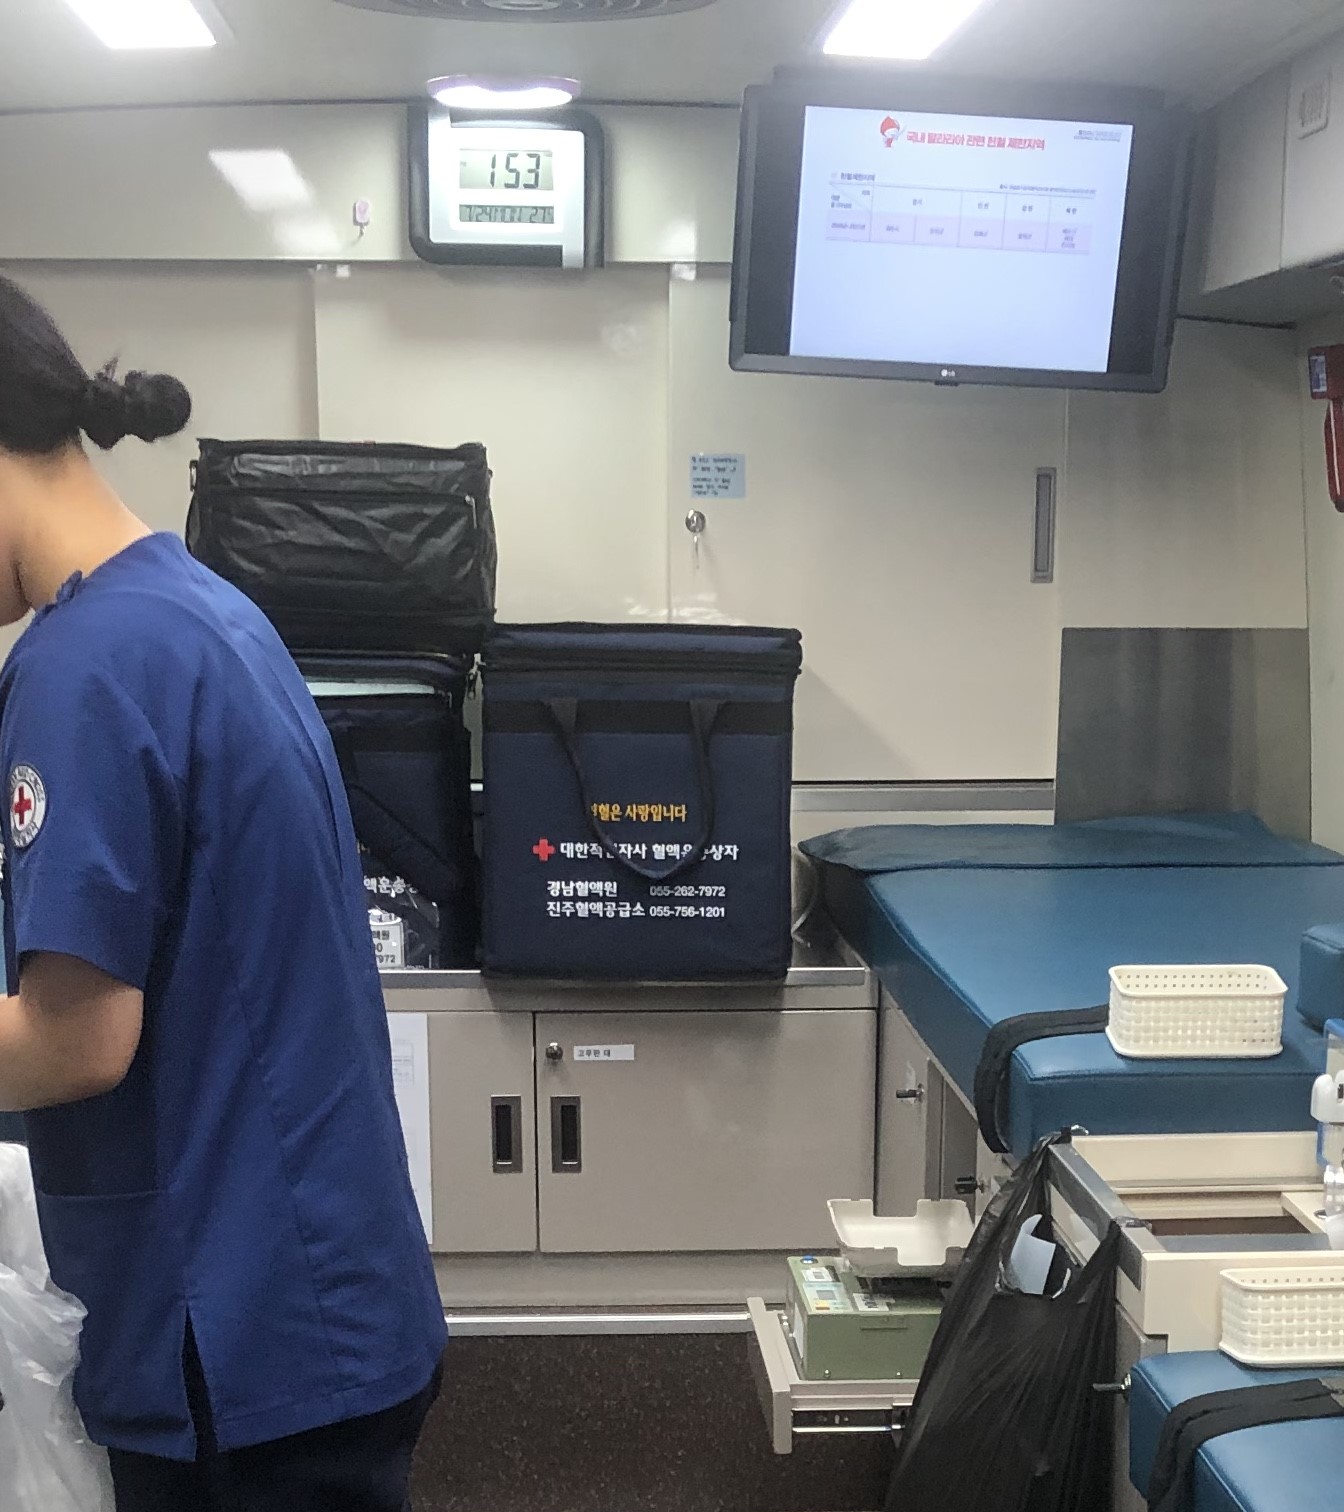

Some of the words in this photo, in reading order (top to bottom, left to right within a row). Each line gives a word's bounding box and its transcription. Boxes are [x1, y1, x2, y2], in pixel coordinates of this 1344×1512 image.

[625, 803, 688, 822] 사랑입니다
[559, 841, 648, 859] 대한적자사
[652, 843, 739, 861] 혈액상자
[546, 880, 618, 898] 경남혈액원
[650, 886, 726, 898] 055-262-7972
[546, 901, 646, 918] 진주혈액공급소
[649, 906, 726, 918] 055-756-1201
